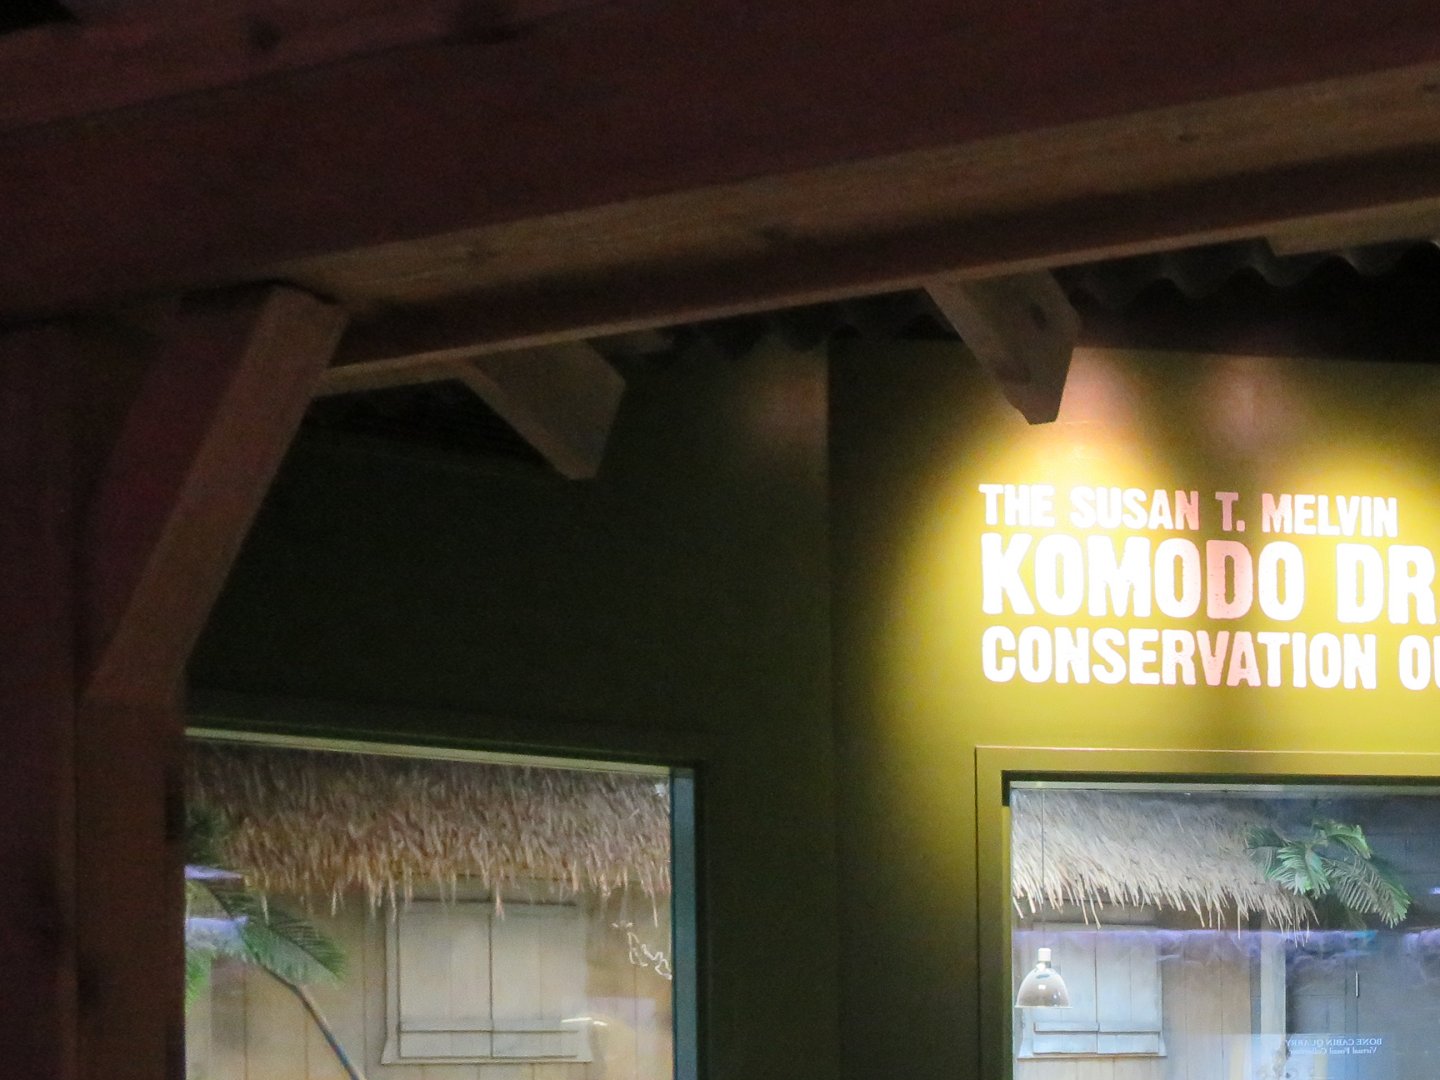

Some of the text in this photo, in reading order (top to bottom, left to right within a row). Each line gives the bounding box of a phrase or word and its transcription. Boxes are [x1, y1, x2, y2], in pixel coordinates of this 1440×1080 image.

[979, 484, 1398, 537] THE SUSAN T. MELVIN
[980, 533, 1304, 622] KOMODO
[981, 625, 1377, 689] CONSERVATION
